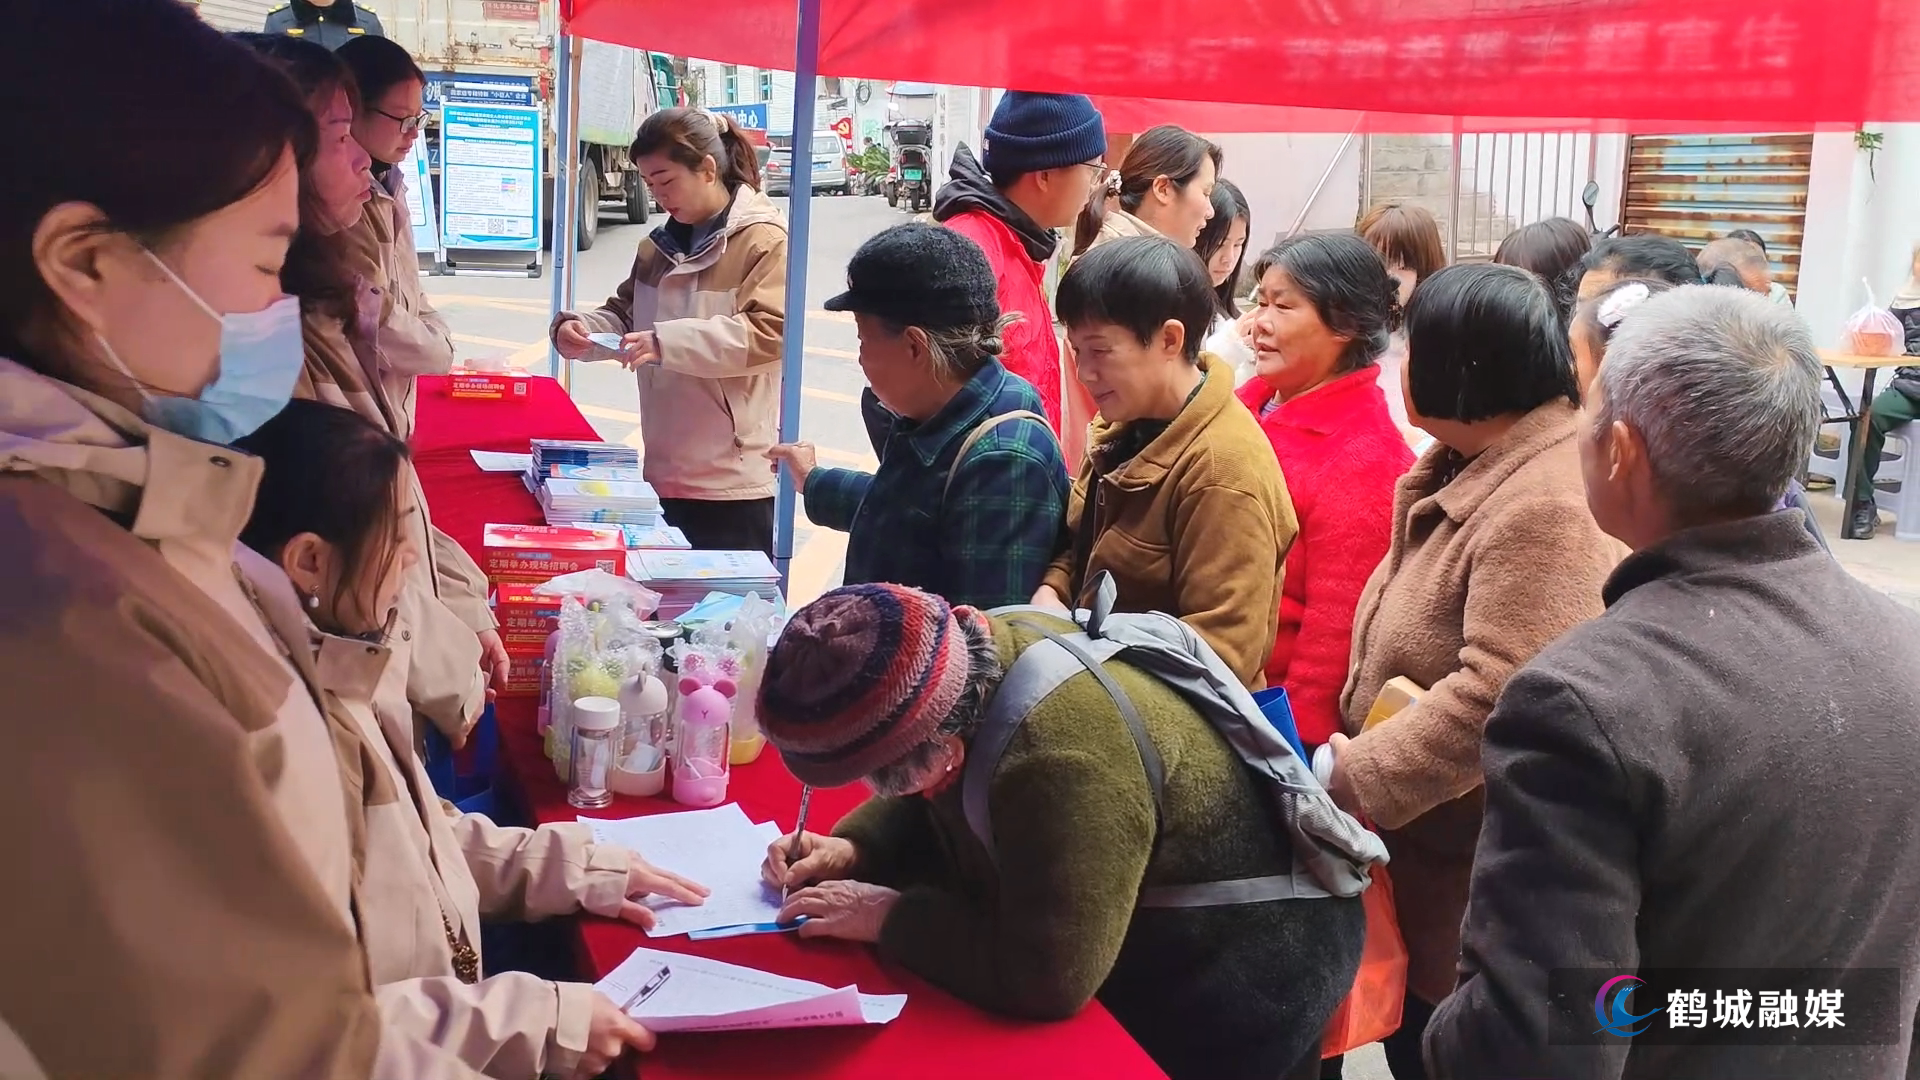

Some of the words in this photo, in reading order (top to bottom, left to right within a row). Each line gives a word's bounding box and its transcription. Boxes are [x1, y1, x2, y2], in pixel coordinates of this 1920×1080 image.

[489, 558, 579, 571] 定期举办现场招聘会
